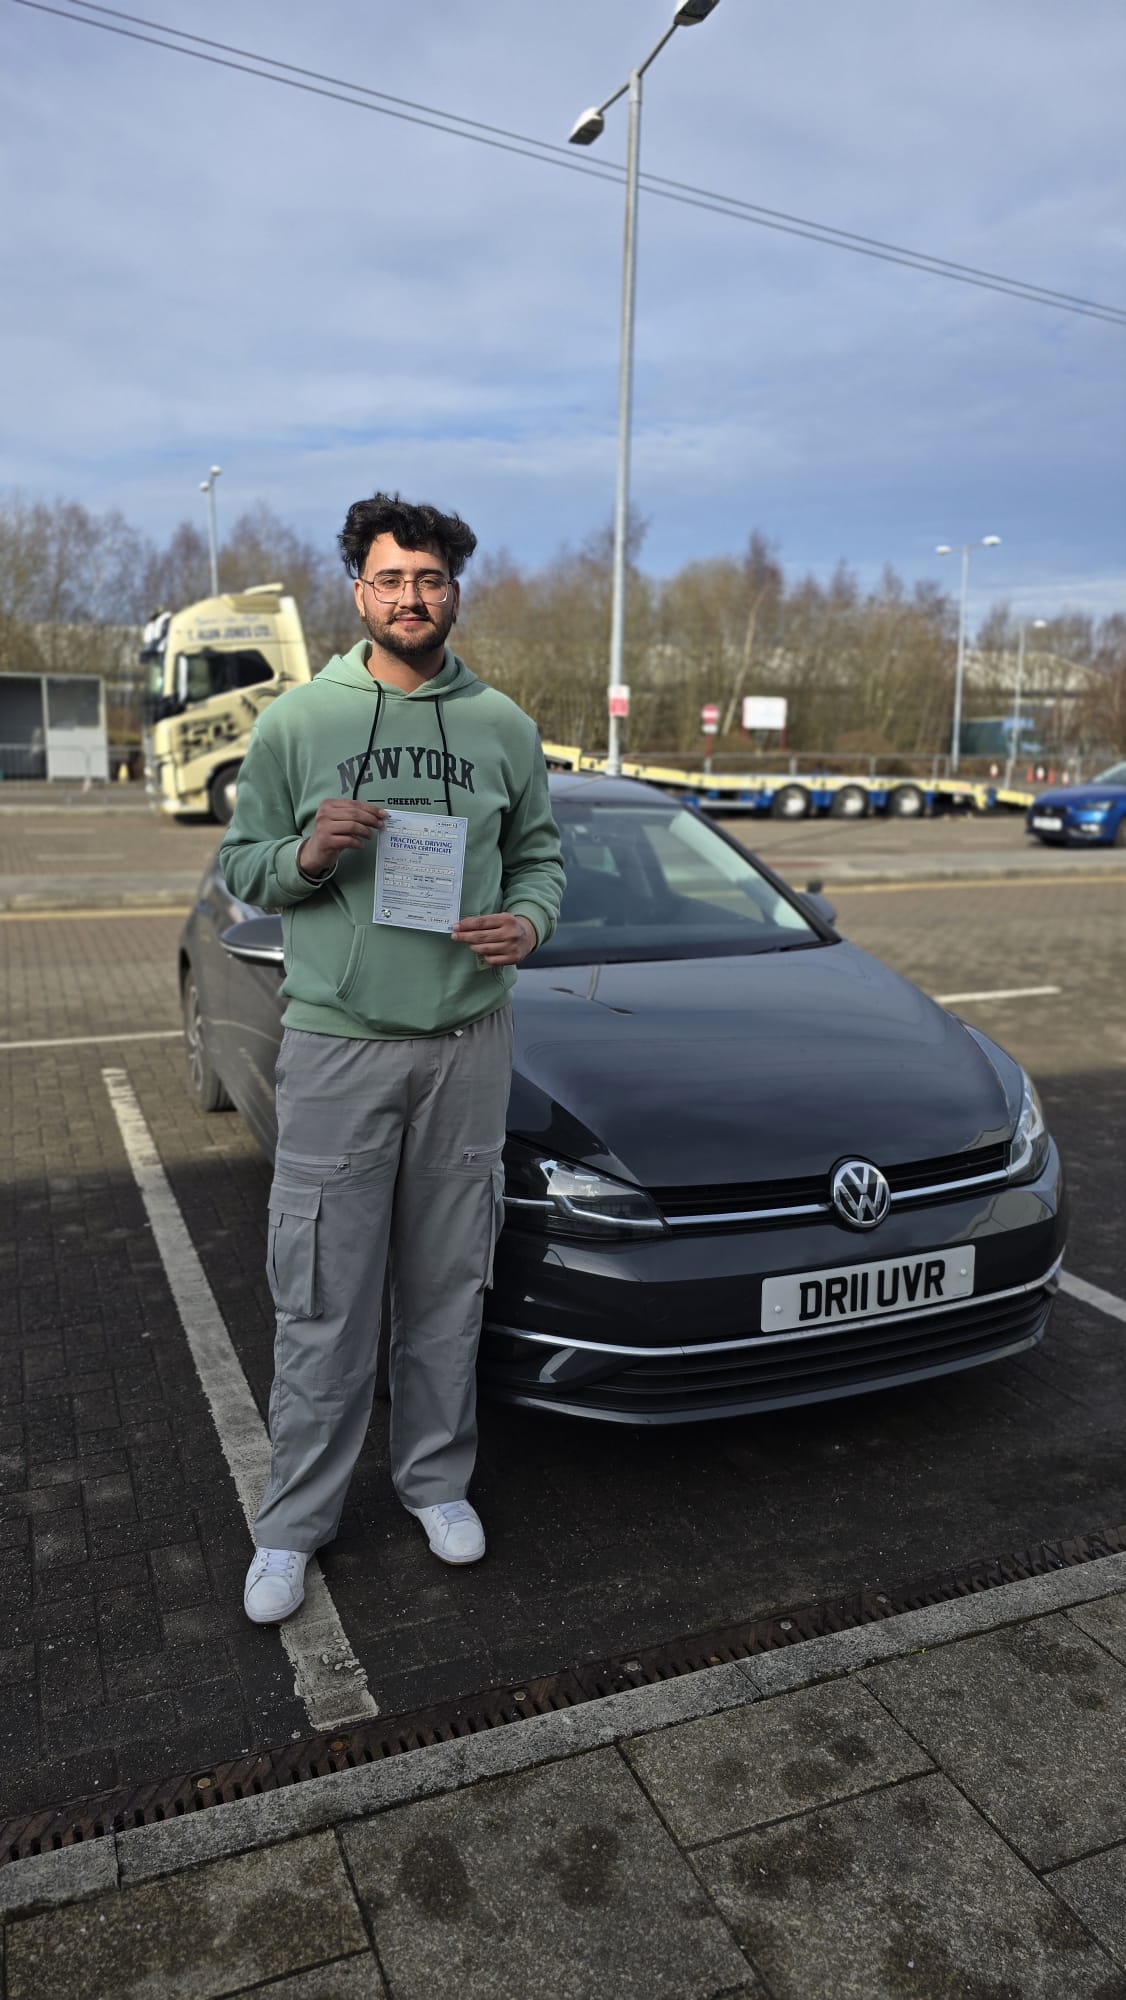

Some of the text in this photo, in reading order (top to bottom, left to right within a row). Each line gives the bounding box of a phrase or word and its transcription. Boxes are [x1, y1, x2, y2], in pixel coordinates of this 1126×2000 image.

[336, 746, 475, 795] NEW YORK
[390, 836, 452, 848] PRACTICAL DRIVING
[418, 845, 452, 854] CERTIFICATE
[799, 1259, 946, 1321] DR11 UVR
